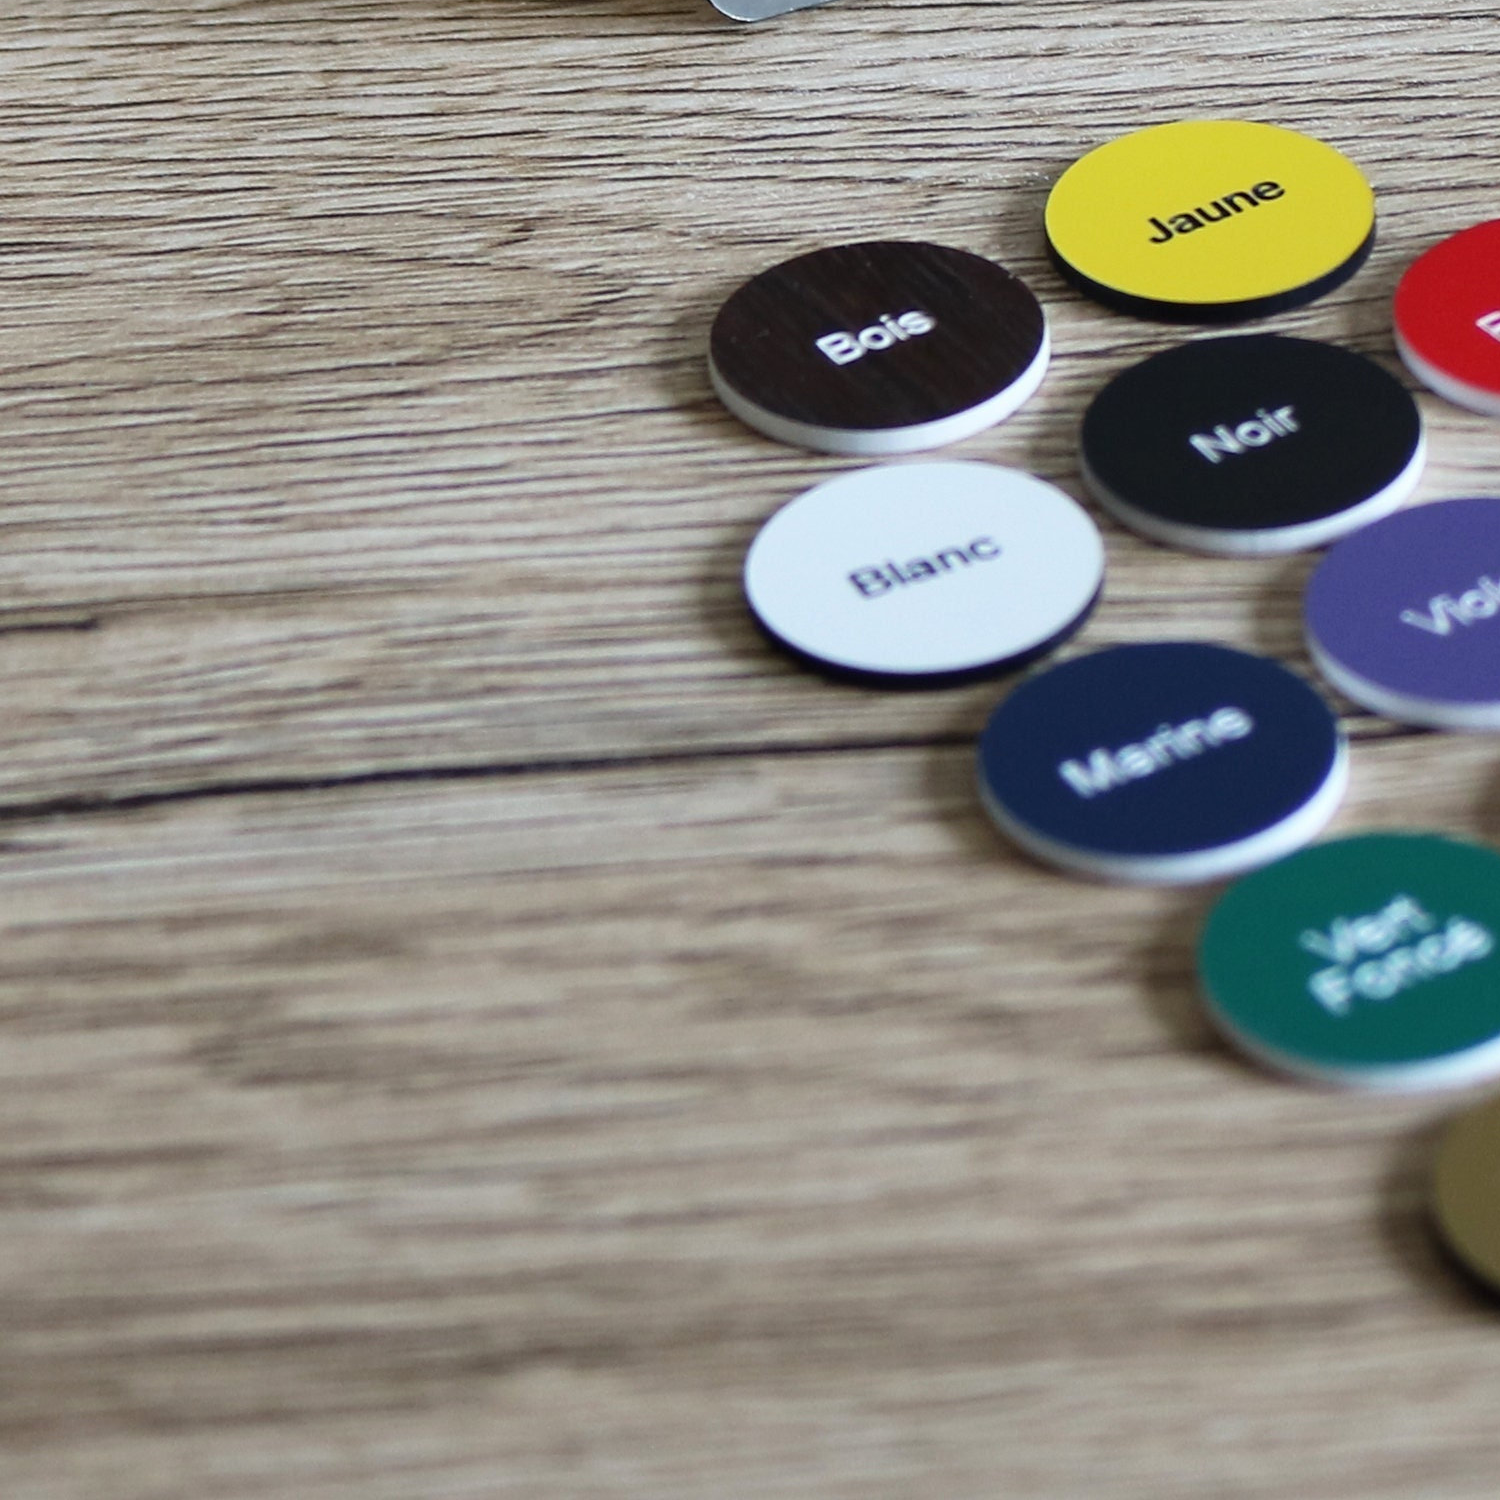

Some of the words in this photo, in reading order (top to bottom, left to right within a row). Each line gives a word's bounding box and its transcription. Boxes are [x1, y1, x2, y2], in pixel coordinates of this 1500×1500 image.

[1148, 181, 1286, 244] Jaune
[814, 310, 935, 366] Bois
[1188, 405, 1298, 464] Noir
[847, 535, 1002, 599] Blanc
[1058, 706, 1252, 798] Marine
[1298, 894, 1436, 963] Vert
